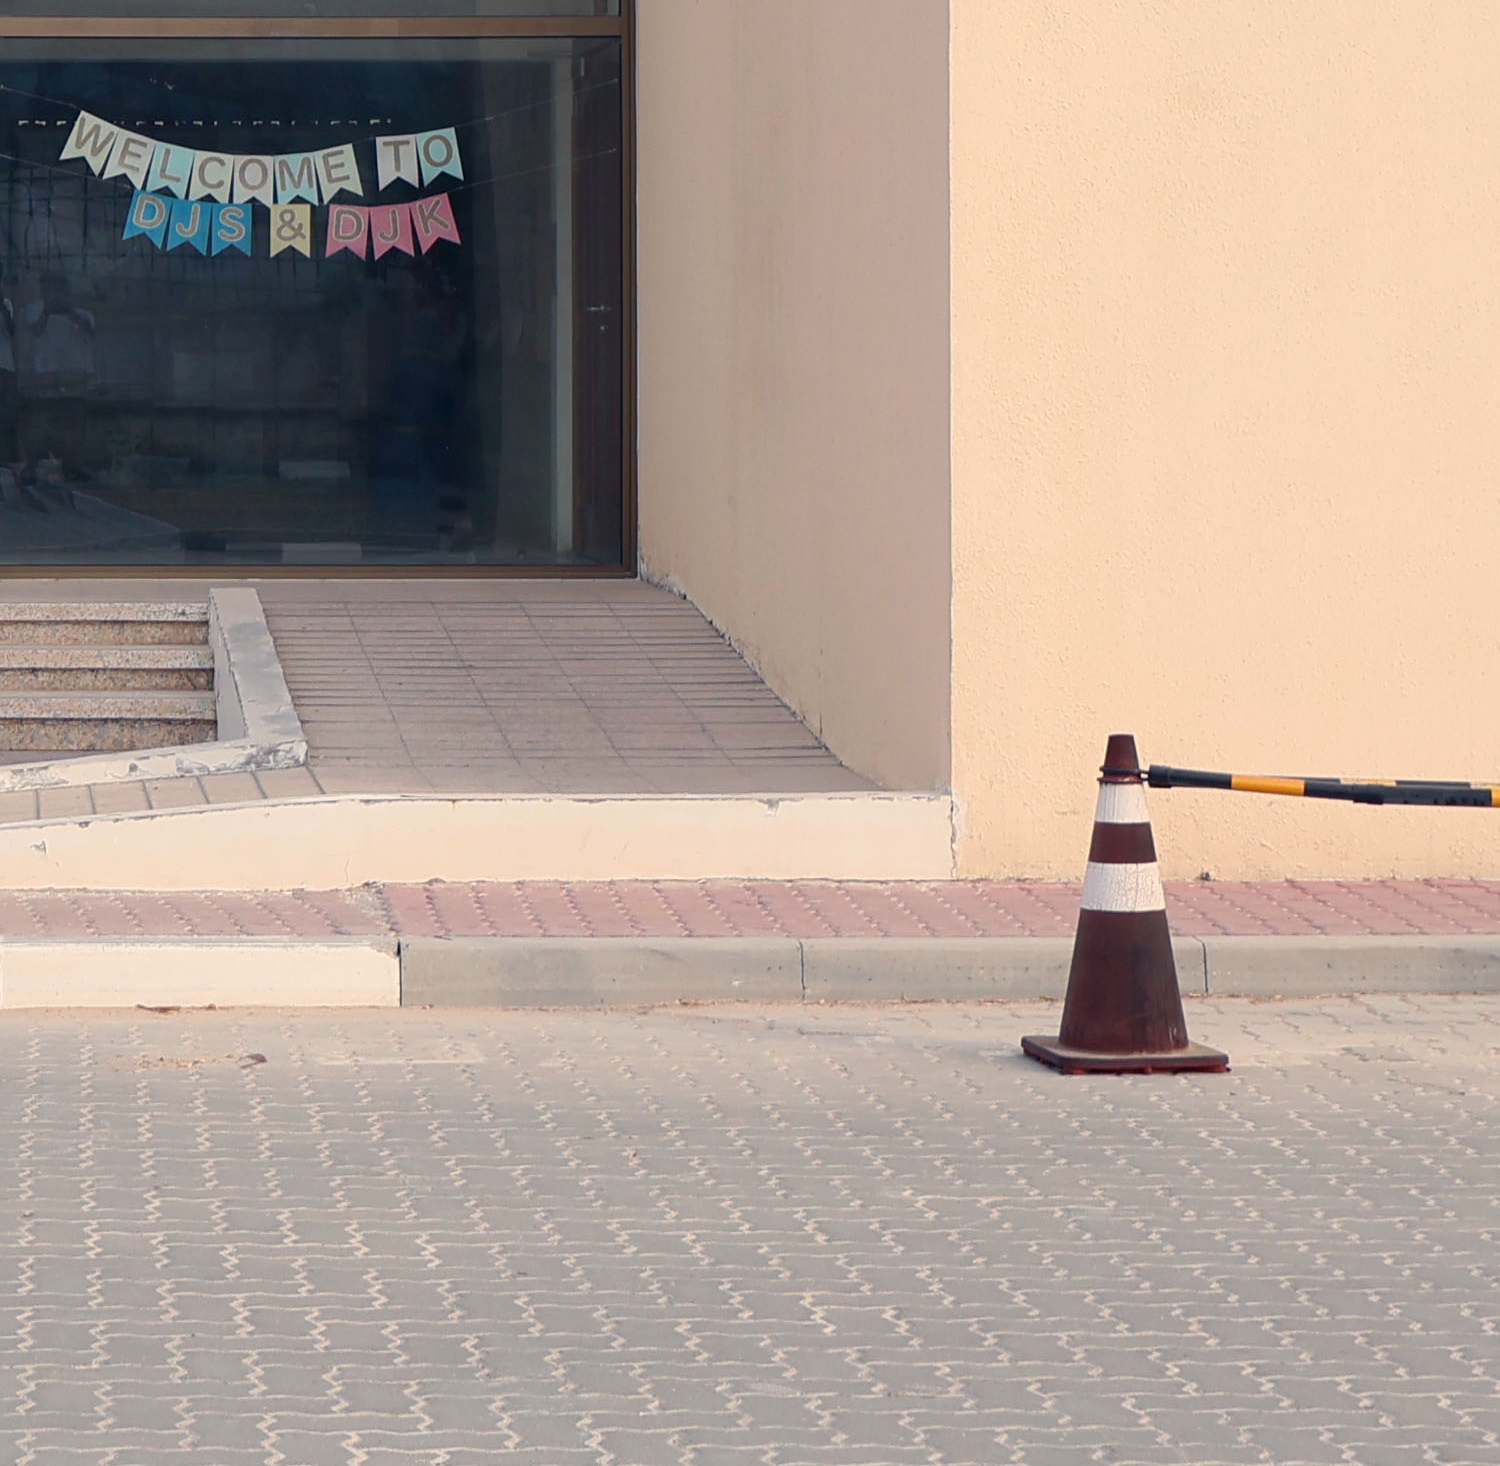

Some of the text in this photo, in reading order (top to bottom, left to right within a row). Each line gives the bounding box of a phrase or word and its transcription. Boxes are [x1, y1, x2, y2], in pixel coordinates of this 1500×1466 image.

[74, 117, 455, 190] WELCOME TO
[131, 194, 451, 242] DJS & DJK
